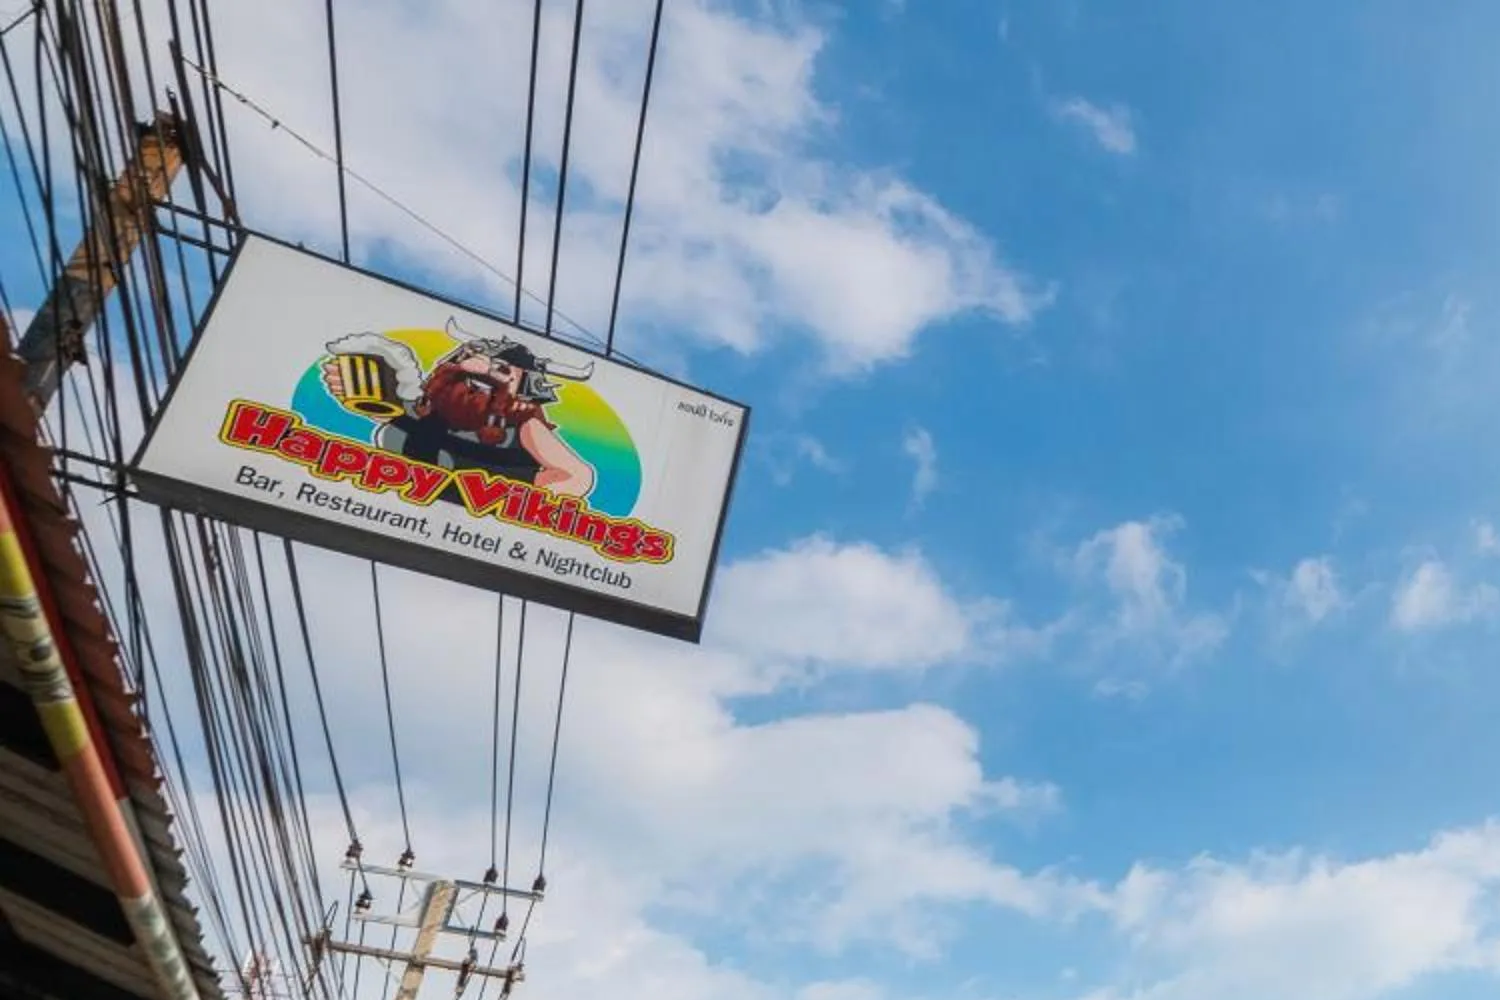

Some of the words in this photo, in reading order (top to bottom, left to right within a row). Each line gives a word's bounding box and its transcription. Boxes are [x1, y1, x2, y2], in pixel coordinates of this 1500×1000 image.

[222, 400, 452, 504] Happy
[456, 469, 675, 562] Vikings
[234, 465, 285, 497] Bar,
[296, 482, 431, 538] Restaurant,
[443, 521, 502, 554] Hotel
[508, 541, 529, 560] &
[535, 549, 633, 589] Nightclub
